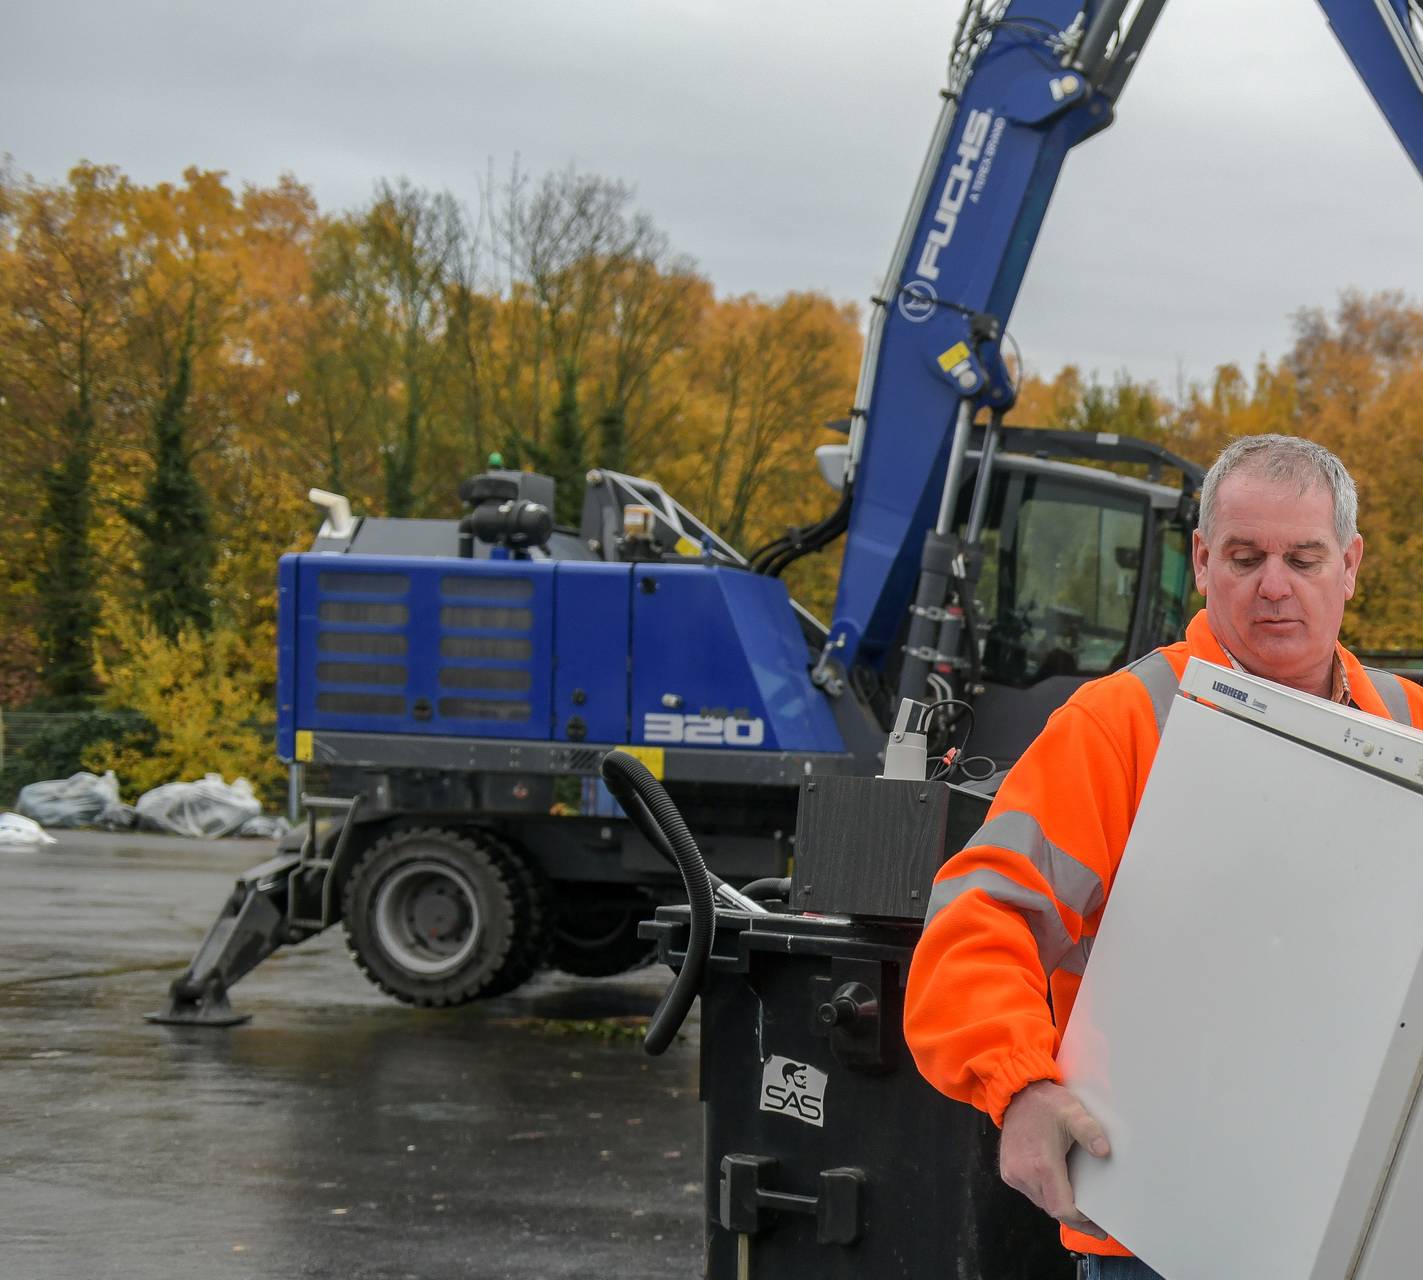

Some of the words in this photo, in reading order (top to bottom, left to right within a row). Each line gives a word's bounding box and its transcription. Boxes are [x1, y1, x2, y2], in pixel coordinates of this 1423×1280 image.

[916, 109, 991, 281] FUCHS
[1212, 681, 1248, 702] LIEBHERR
[644, 712, 764, 745] 320
[764, 1084, 822, 1121] SAS
